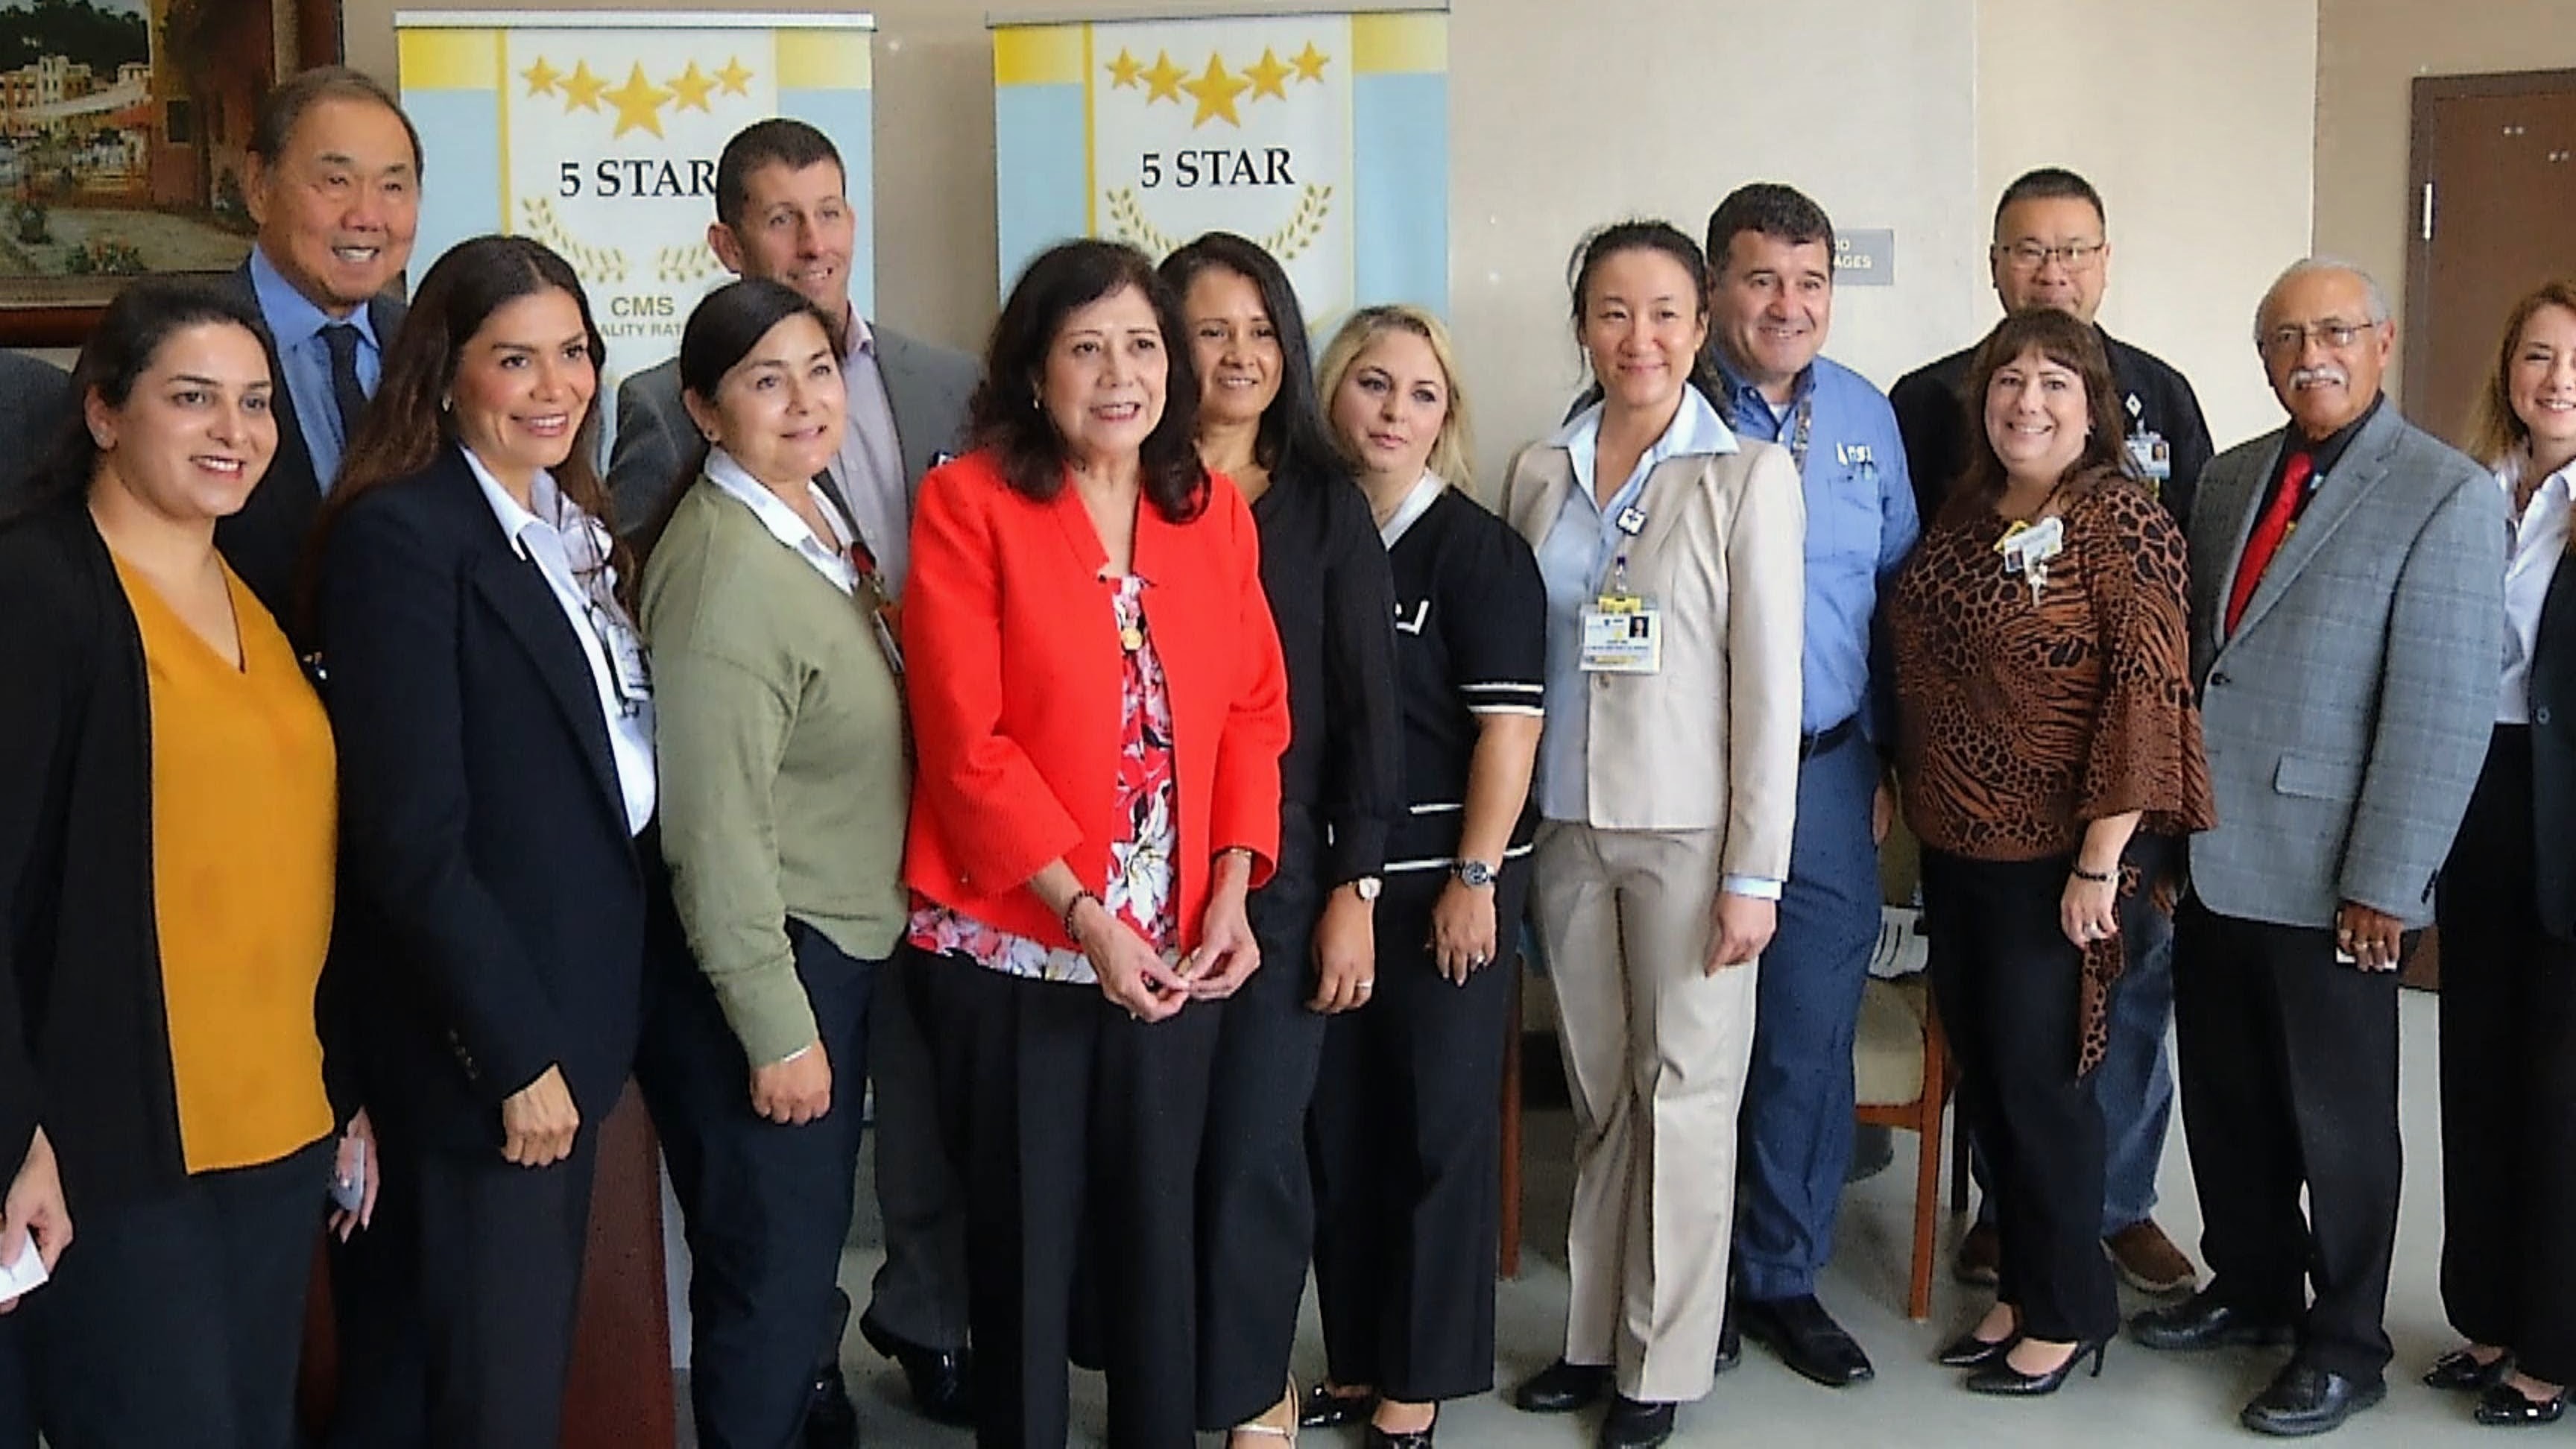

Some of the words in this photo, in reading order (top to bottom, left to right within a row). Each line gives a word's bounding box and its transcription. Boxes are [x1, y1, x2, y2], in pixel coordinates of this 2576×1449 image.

[1141, 153, 1161, 188] 5
[1175, 148, 1295, 188] STAR
[560, 162, 581, 197] 5
[596, 159, 716, 197] STAR
[1834, 255, 1872, 268] AGES
[611, 297, 675, 316] CMS
[600, 323, 645, 336] ALITY
[651, 323, 681, 336] RAT
